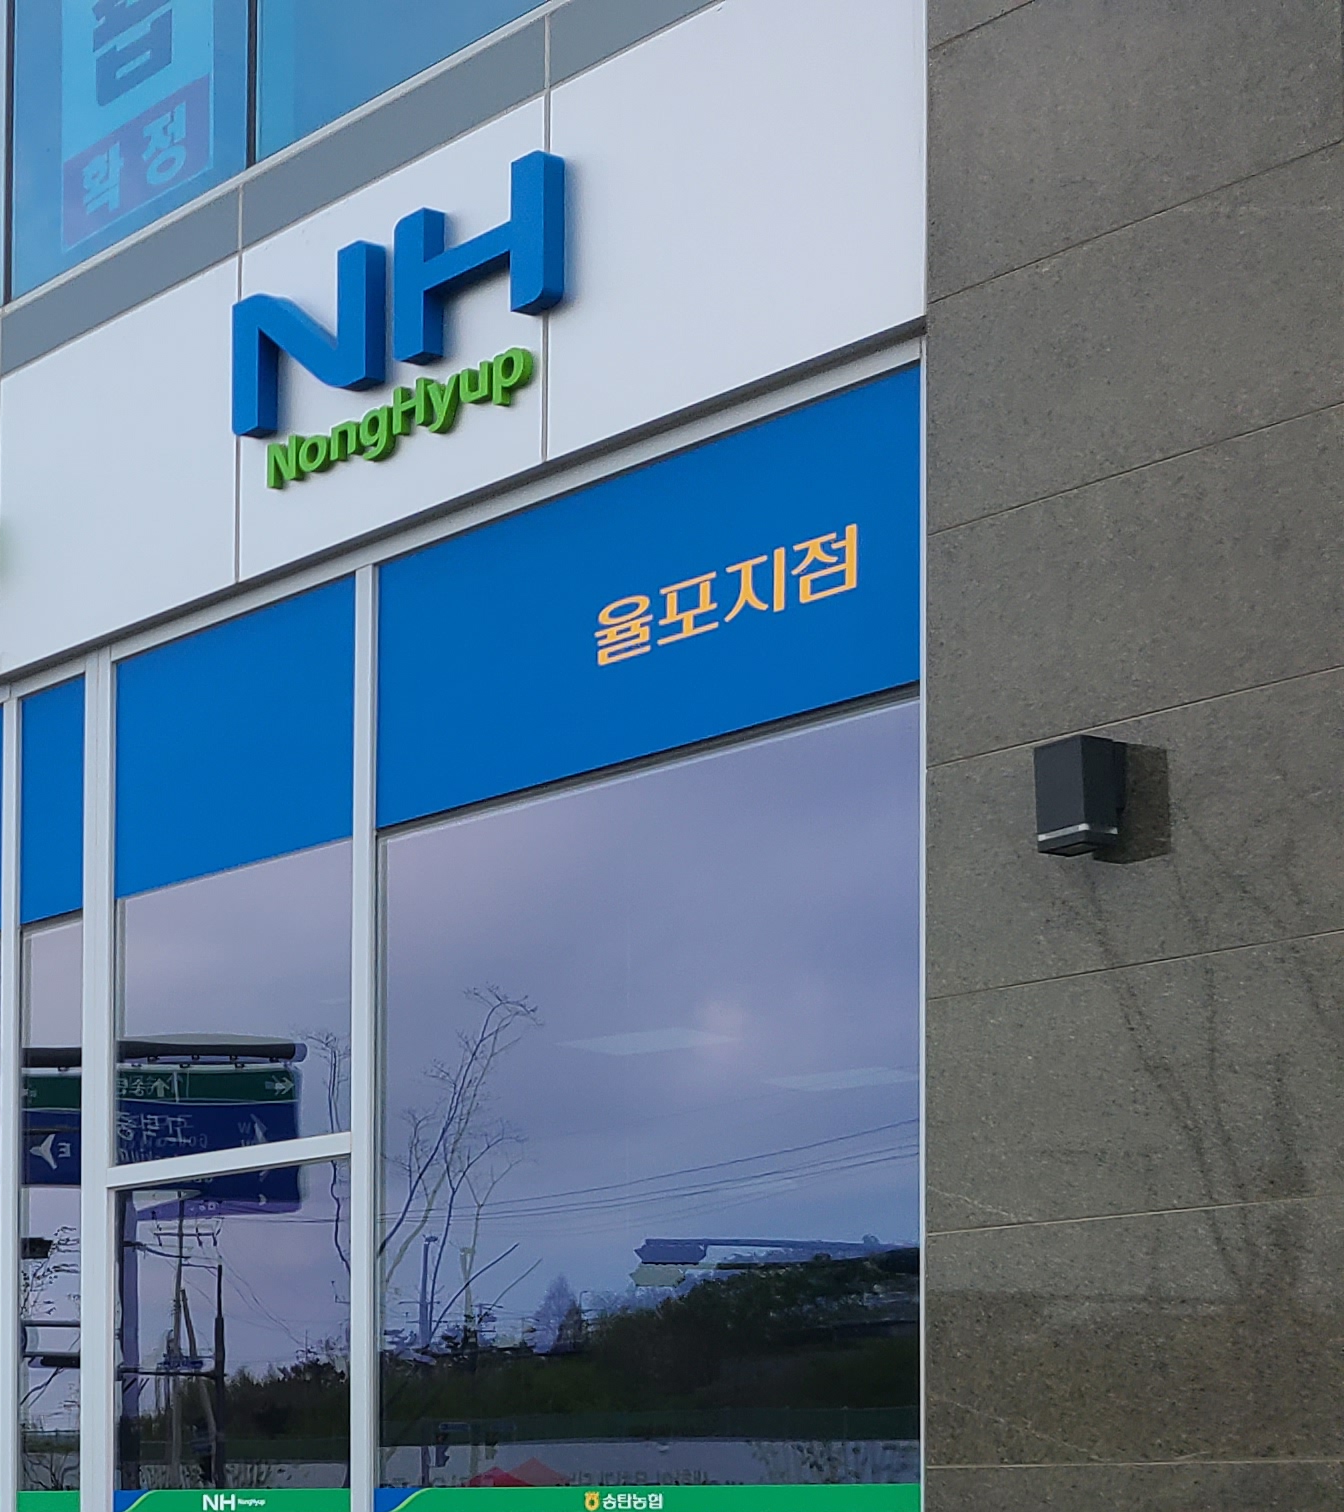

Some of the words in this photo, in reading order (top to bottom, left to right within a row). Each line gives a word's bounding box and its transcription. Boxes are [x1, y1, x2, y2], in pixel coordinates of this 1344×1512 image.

[83, 101, 186, 216] 확정
[232, 148, 567, 438] NH
[265, 346, 534, 490] NongHyup
[594, 523, 858, 667] 율포지점
[203, 1494, 236, 1511] NH
[602, 1492, 663, 1510] 송탄농협
